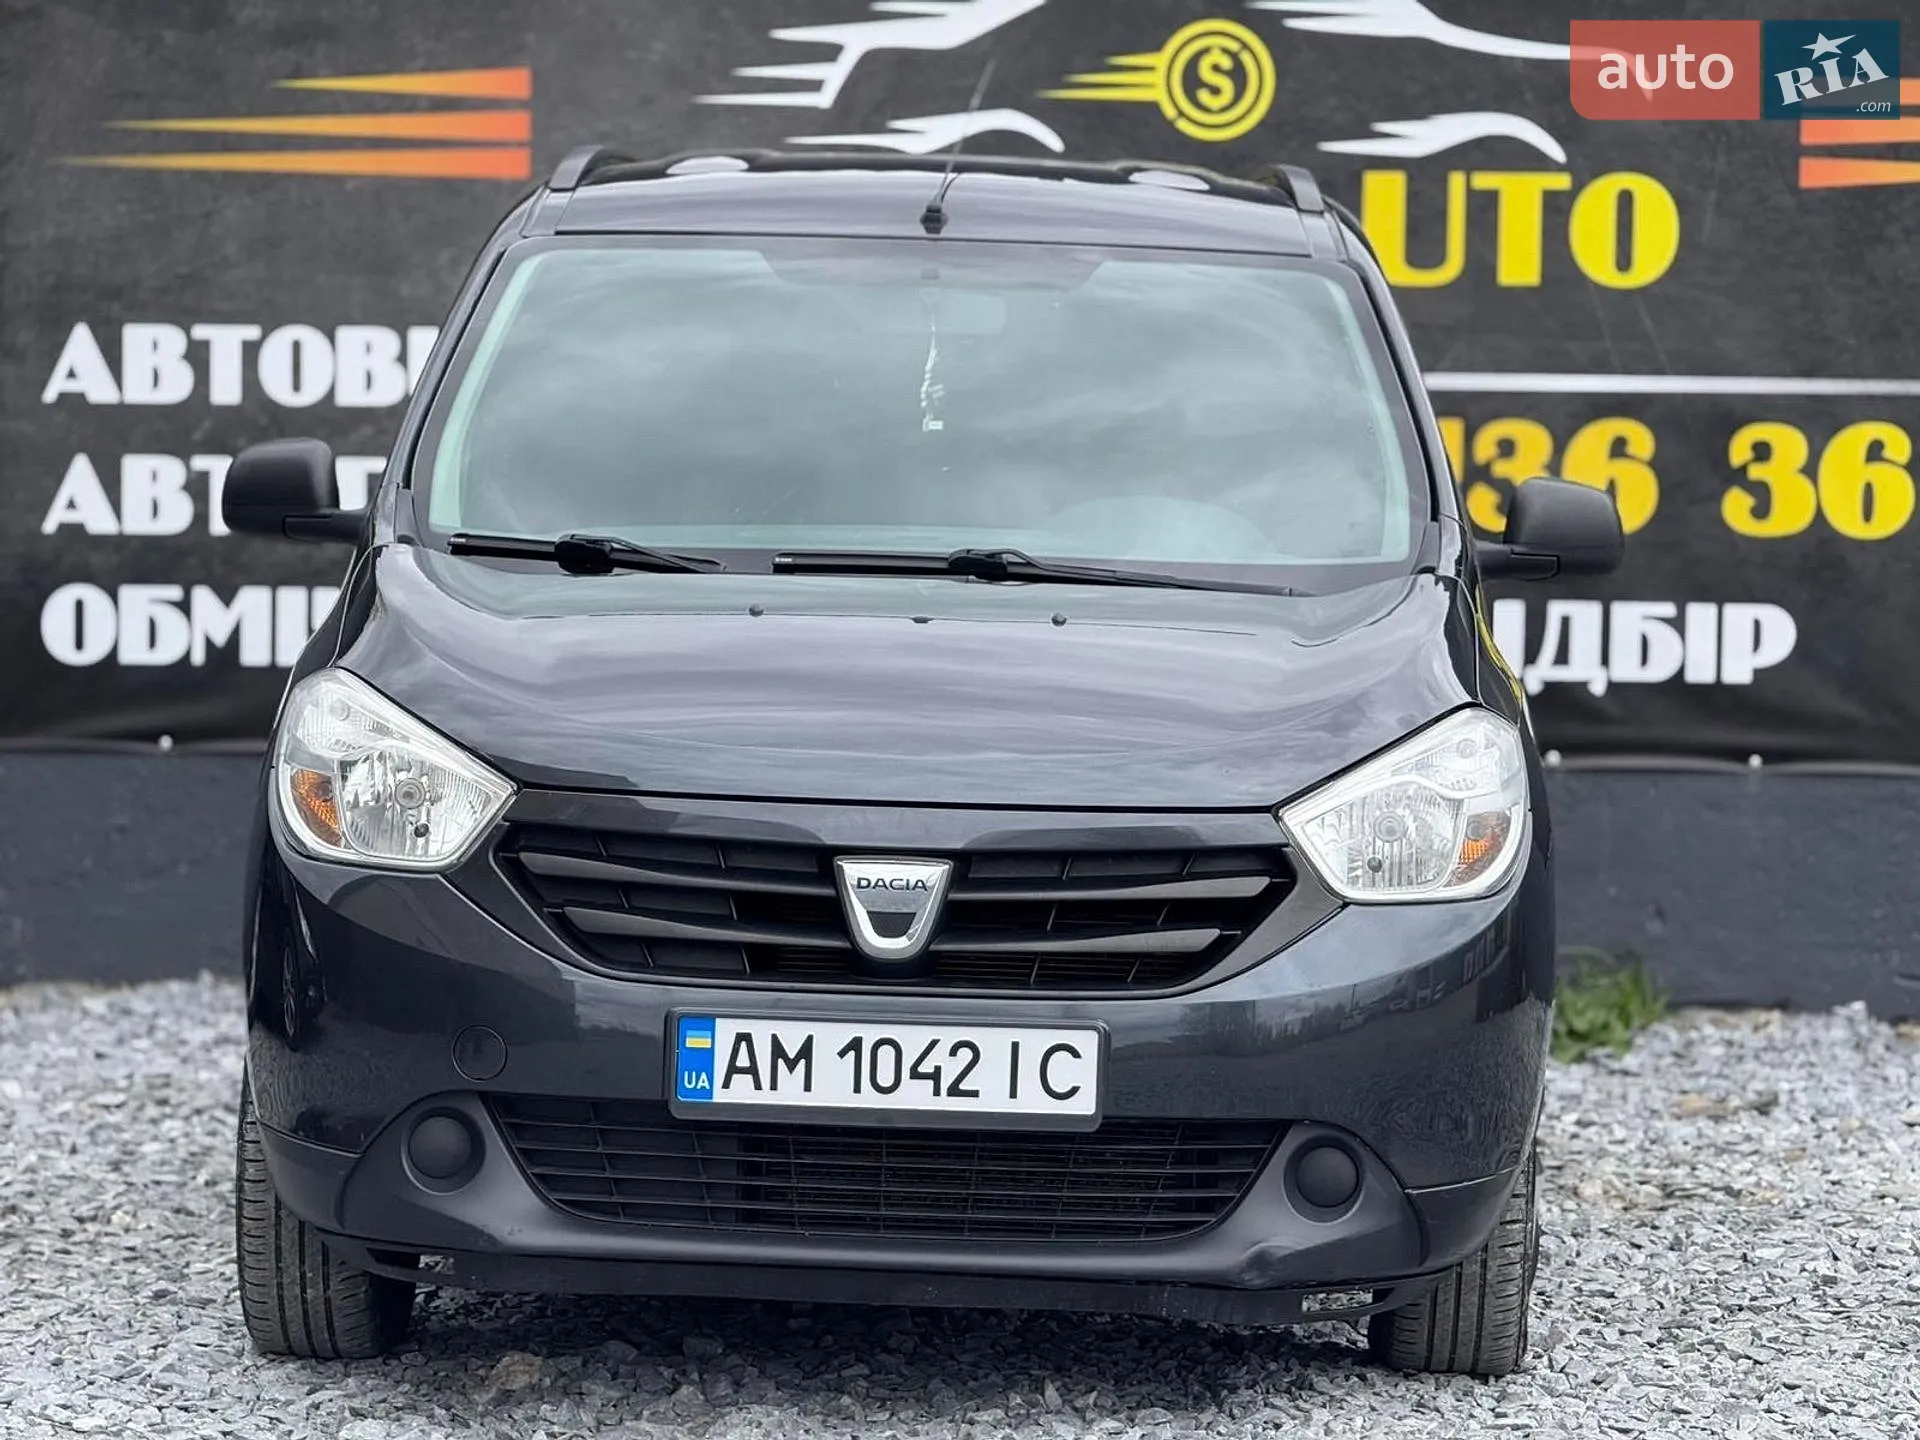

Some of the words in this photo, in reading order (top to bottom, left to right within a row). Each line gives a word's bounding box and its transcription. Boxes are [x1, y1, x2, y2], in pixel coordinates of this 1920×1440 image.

[1721, 420, 1917, 540] 36
[856, 877, 928, 892] DACIA
[684, 1071, 710, 1090] UA
[721, 1032, 814, 1093] AM
[836, 1035, 981, 1099] 1042
